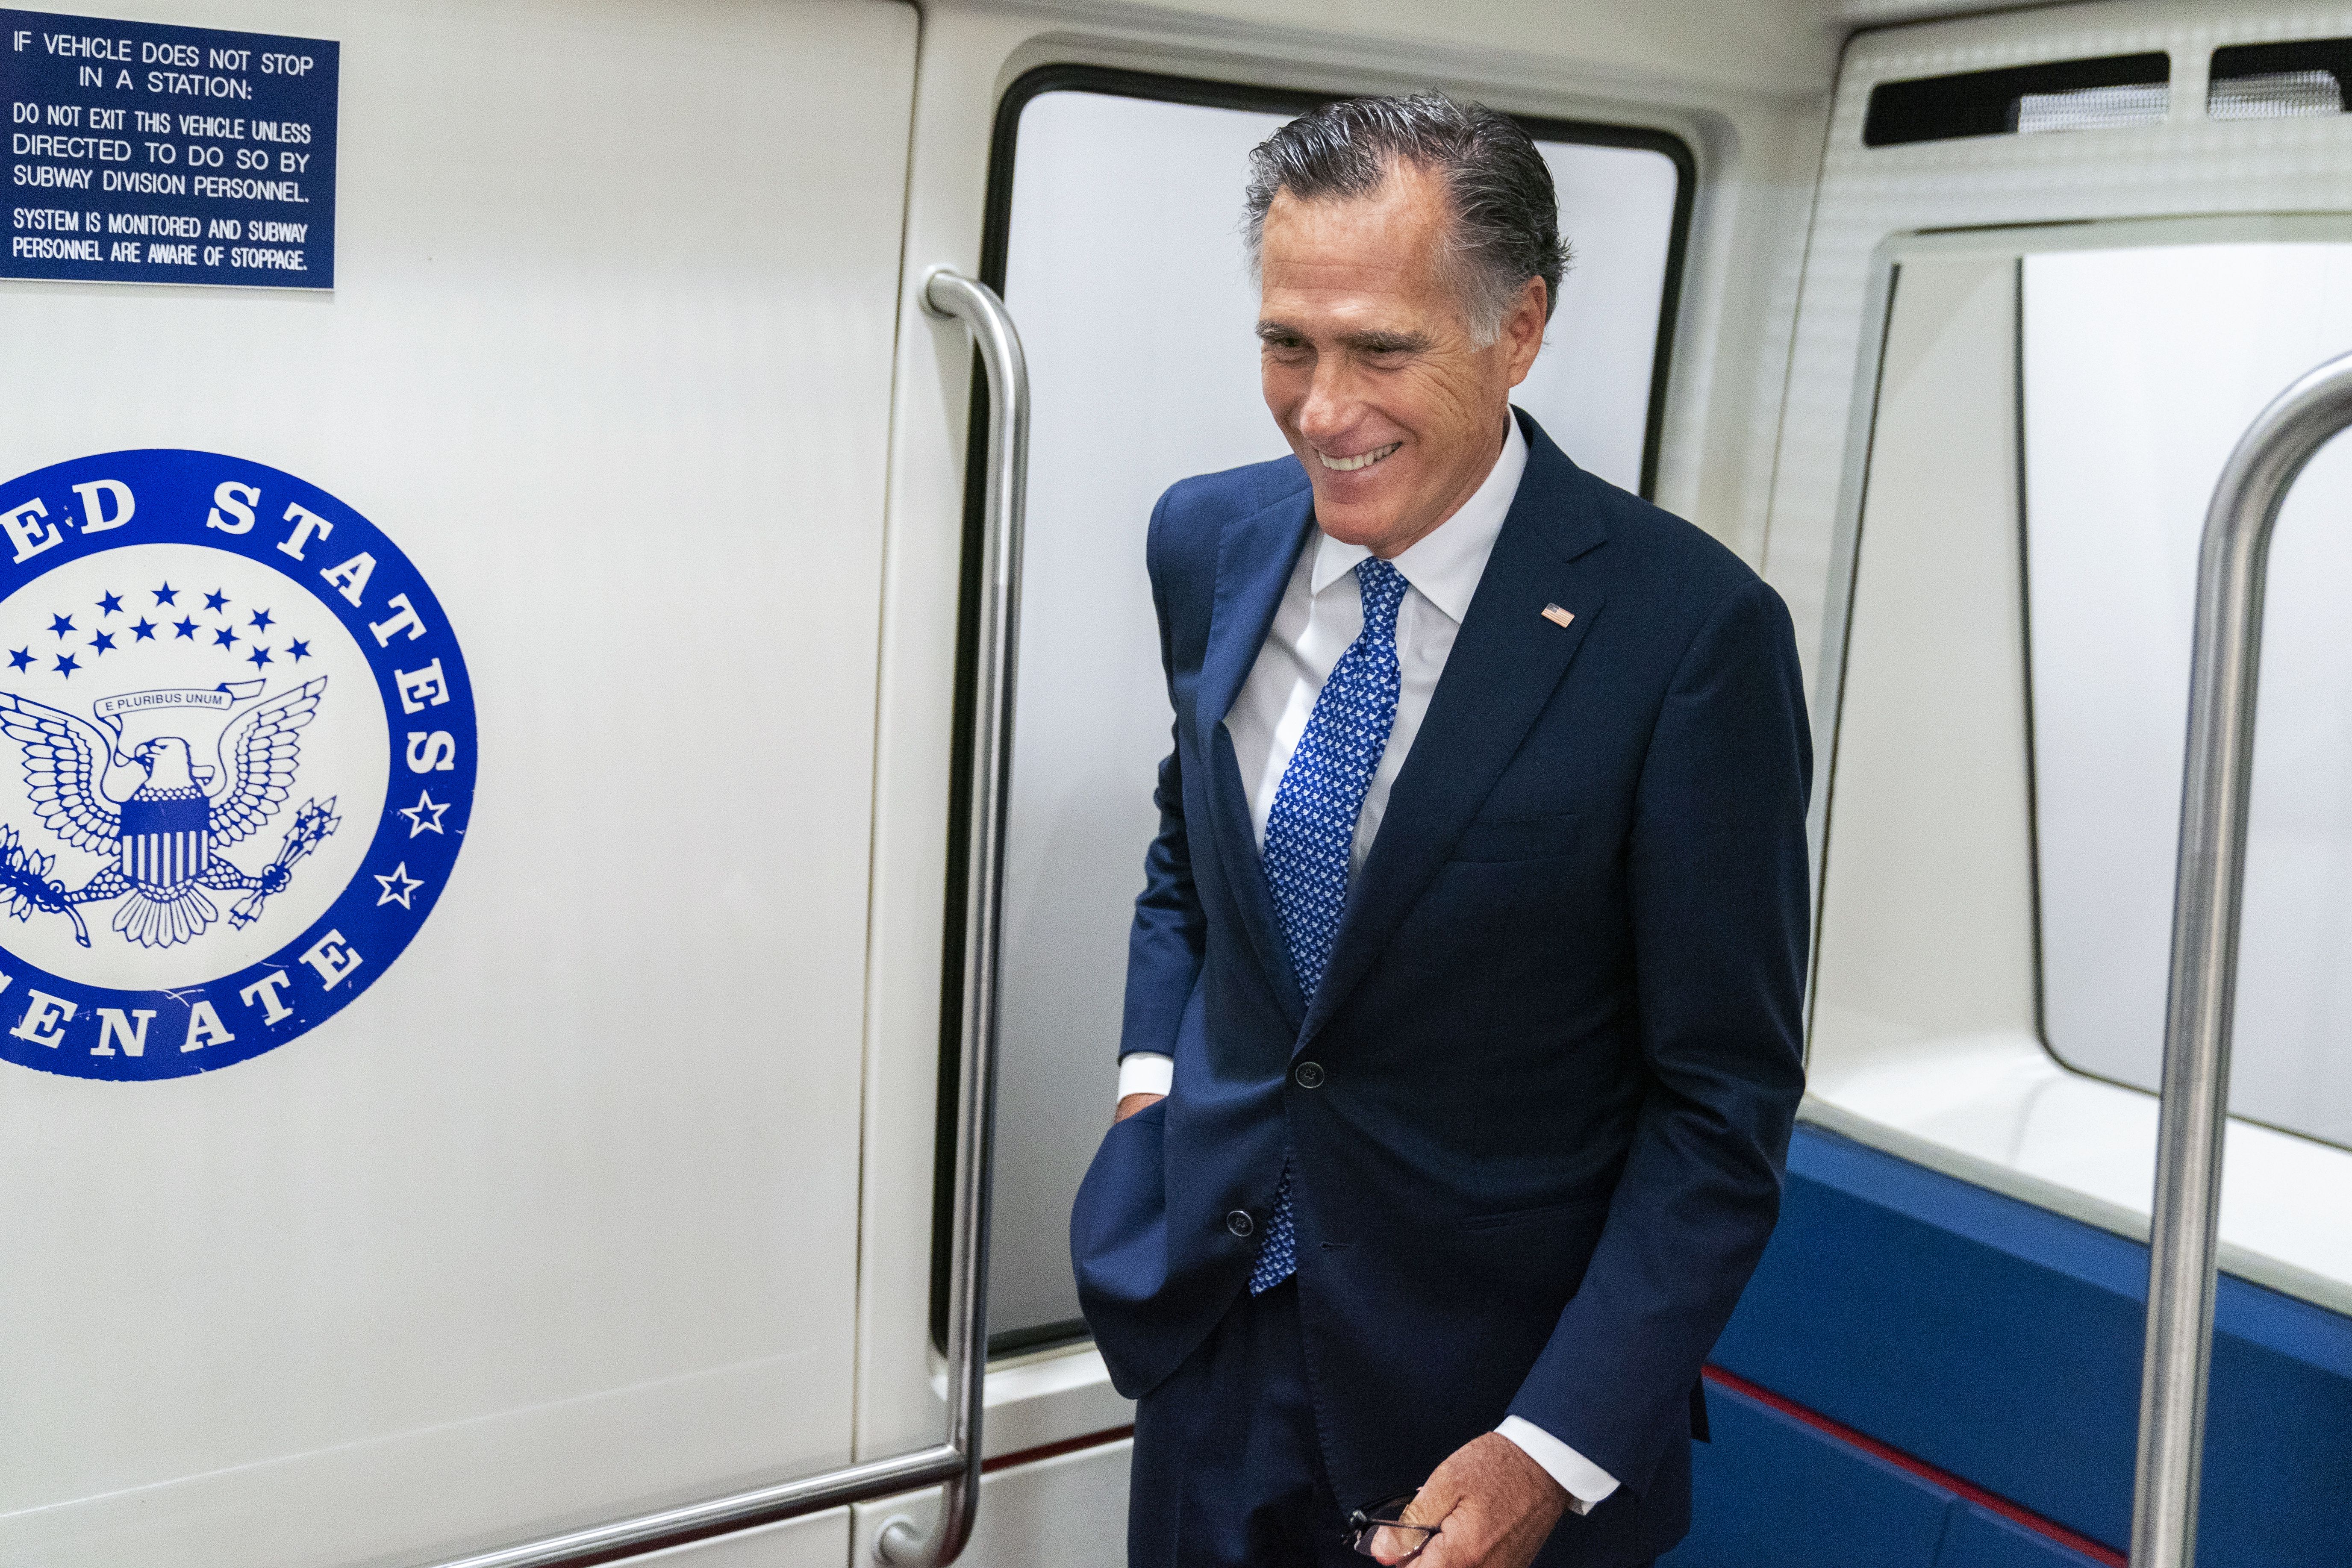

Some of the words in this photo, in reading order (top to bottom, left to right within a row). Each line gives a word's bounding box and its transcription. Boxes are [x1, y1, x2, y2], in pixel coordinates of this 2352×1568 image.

[15, 31, 31, 51] IF
[44, 33, 132, 61] VEHICLE
[143, 42, 199, 67] DOES
[210, 49, 250, 71] NOT
[262, 53, 313, 76] STOP
[80, 66, 102, 87] IN
[116, 70, 133, 89] A
[148, 72, 252, 99] STATION:
[14, 103, 39, 123] DO
[48, 105, 81, 126] NOT
[90, 108, 126, 129] EXIT
[135, 111, 170, 133] THIS
[179, 115, 244, 139] VEHICLE
[252, 121, 311, 144] UNLESS
[14, 134, 131, 161] DIRECTED
[145, 142, 176, 164] TO
[189, 146, 223, 167] DO
[236, 149, 268, 170] SO
[281, 152, 309, 173] BY
[14, 165, 93, 189] SUBWAY
[103, 171, 185, 194] DIVISION
[194, 176, 309, 202] PERSONNEL.
[14, 208, 78, 231] SYSTEM
[86, 212, 100, 232] IS
[109, 214, 201, 237] MONITORED
[209, 219, 241, 239] AND
[249, 221, 308, 243] SUBWAY
[13, 237, 103, 261] PERSONNEL
[111, 242, 140, 262] ARE
[148, 244, 197, 265] AWARE
[204, 246, 224, 266] OF
[231, 247, 307, 270] STOPPAGE.
[206, 482, 455, 774] STATES
[106, 702, 114, 712] E
[117, 693, 181, 709] PLURIBUS
[185, 693, 222, 705] UNUM
[0, 929, 363, 1056] ENATE
